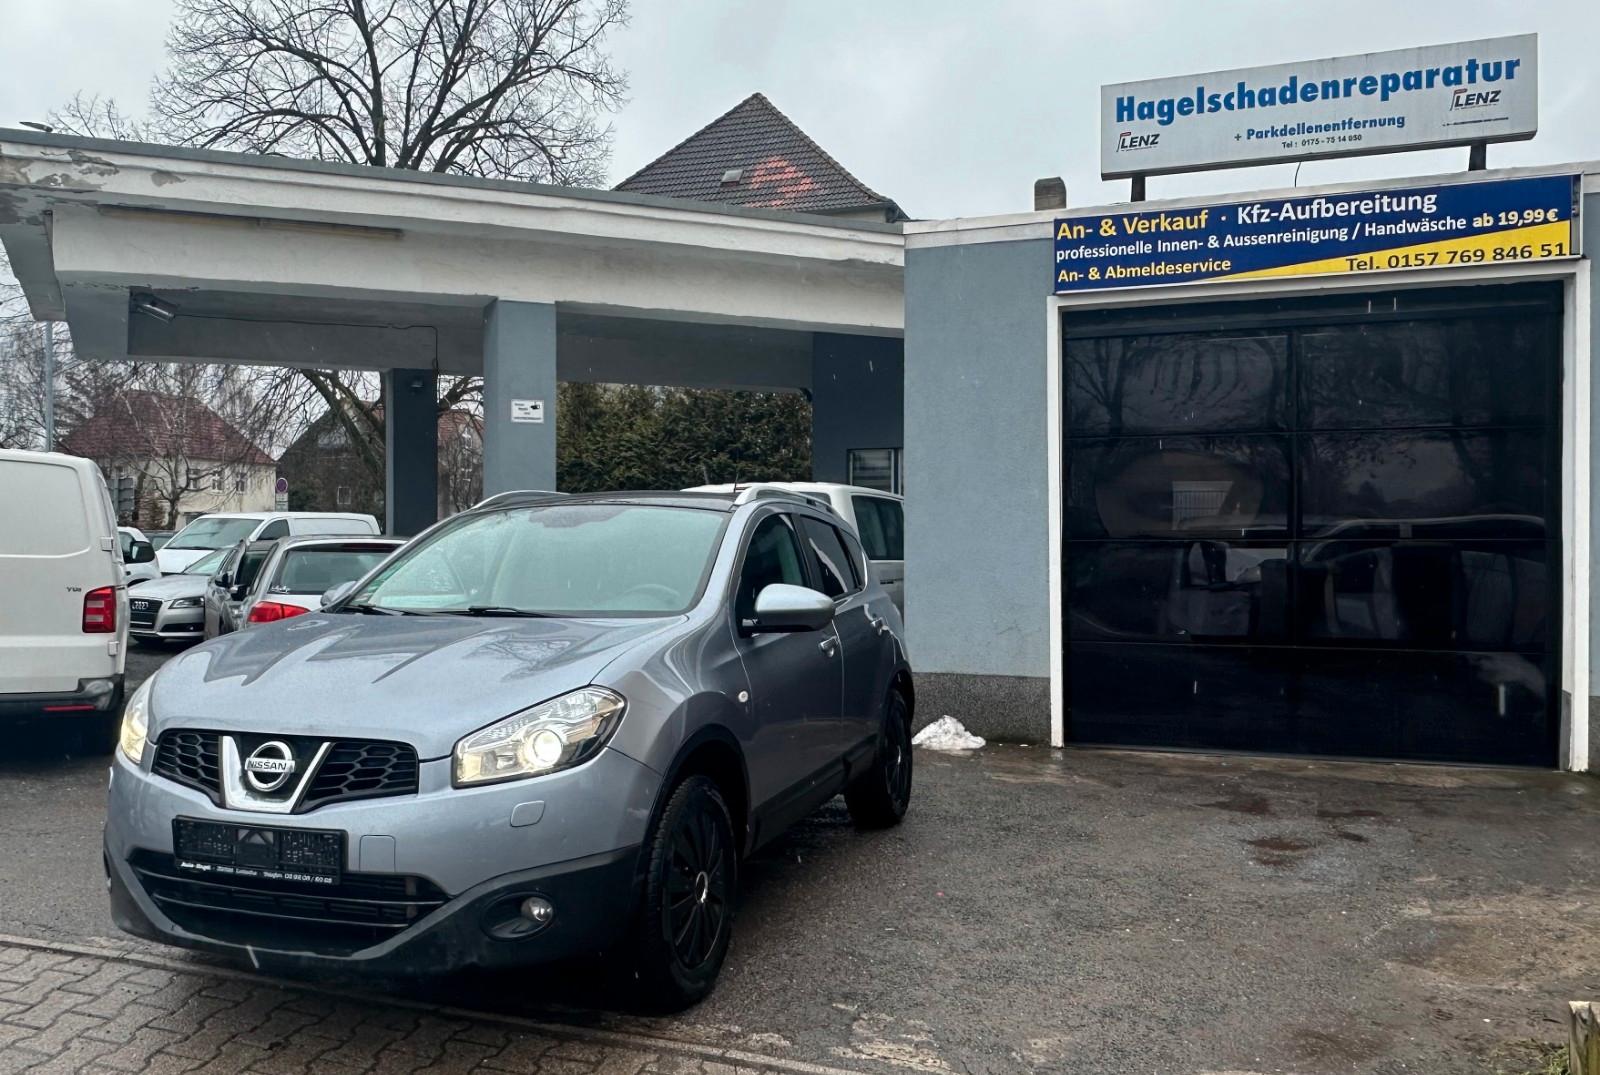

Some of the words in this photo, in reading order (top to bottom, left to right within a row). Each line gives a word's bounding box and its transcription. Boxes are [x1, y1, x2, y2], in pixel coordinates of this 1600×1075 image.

[1116, 58, 1520, 126] Hagelschadenreparatur
[1453, 89, 1501, 108] LENZ
[1246, 116, 1406, 140] Parkdellenentfernung
[1120, 133, 1160, 149] LENZ
[1057, 222, 1093, 241] An-
[1100, 218, 1117, 237] &
[1123, 209, 1209, 234] Verkauf
[1237, 193, 1437, 225] Kfz-Aufbereitung
[1056, 240, 1152, 263] professionelle
[1157, 239, 1203, 253] Innen-
[1207, 234, 1220, 249] &
[1223, 226, 1349, 248] Aussenreinigung
[1364, 216, 1467, 237] Handwäsche
[1472, 212, 1494, 228] ab
[1346, 256, 1380, 272] Tel.
[1387, 252, 1439, 269] 0157
[1447, 249, 1485, 265] 769
[1492, 244, 1533, 261] 846
[1540, 242, 1566, 258] 51
[1057, 269, 1084, 283] An-
[1088, 266, 1102, 281] &
[1105, 258, 1232, 279] Abmeldeservice
[248, 760, 287, 771] NISSAN
